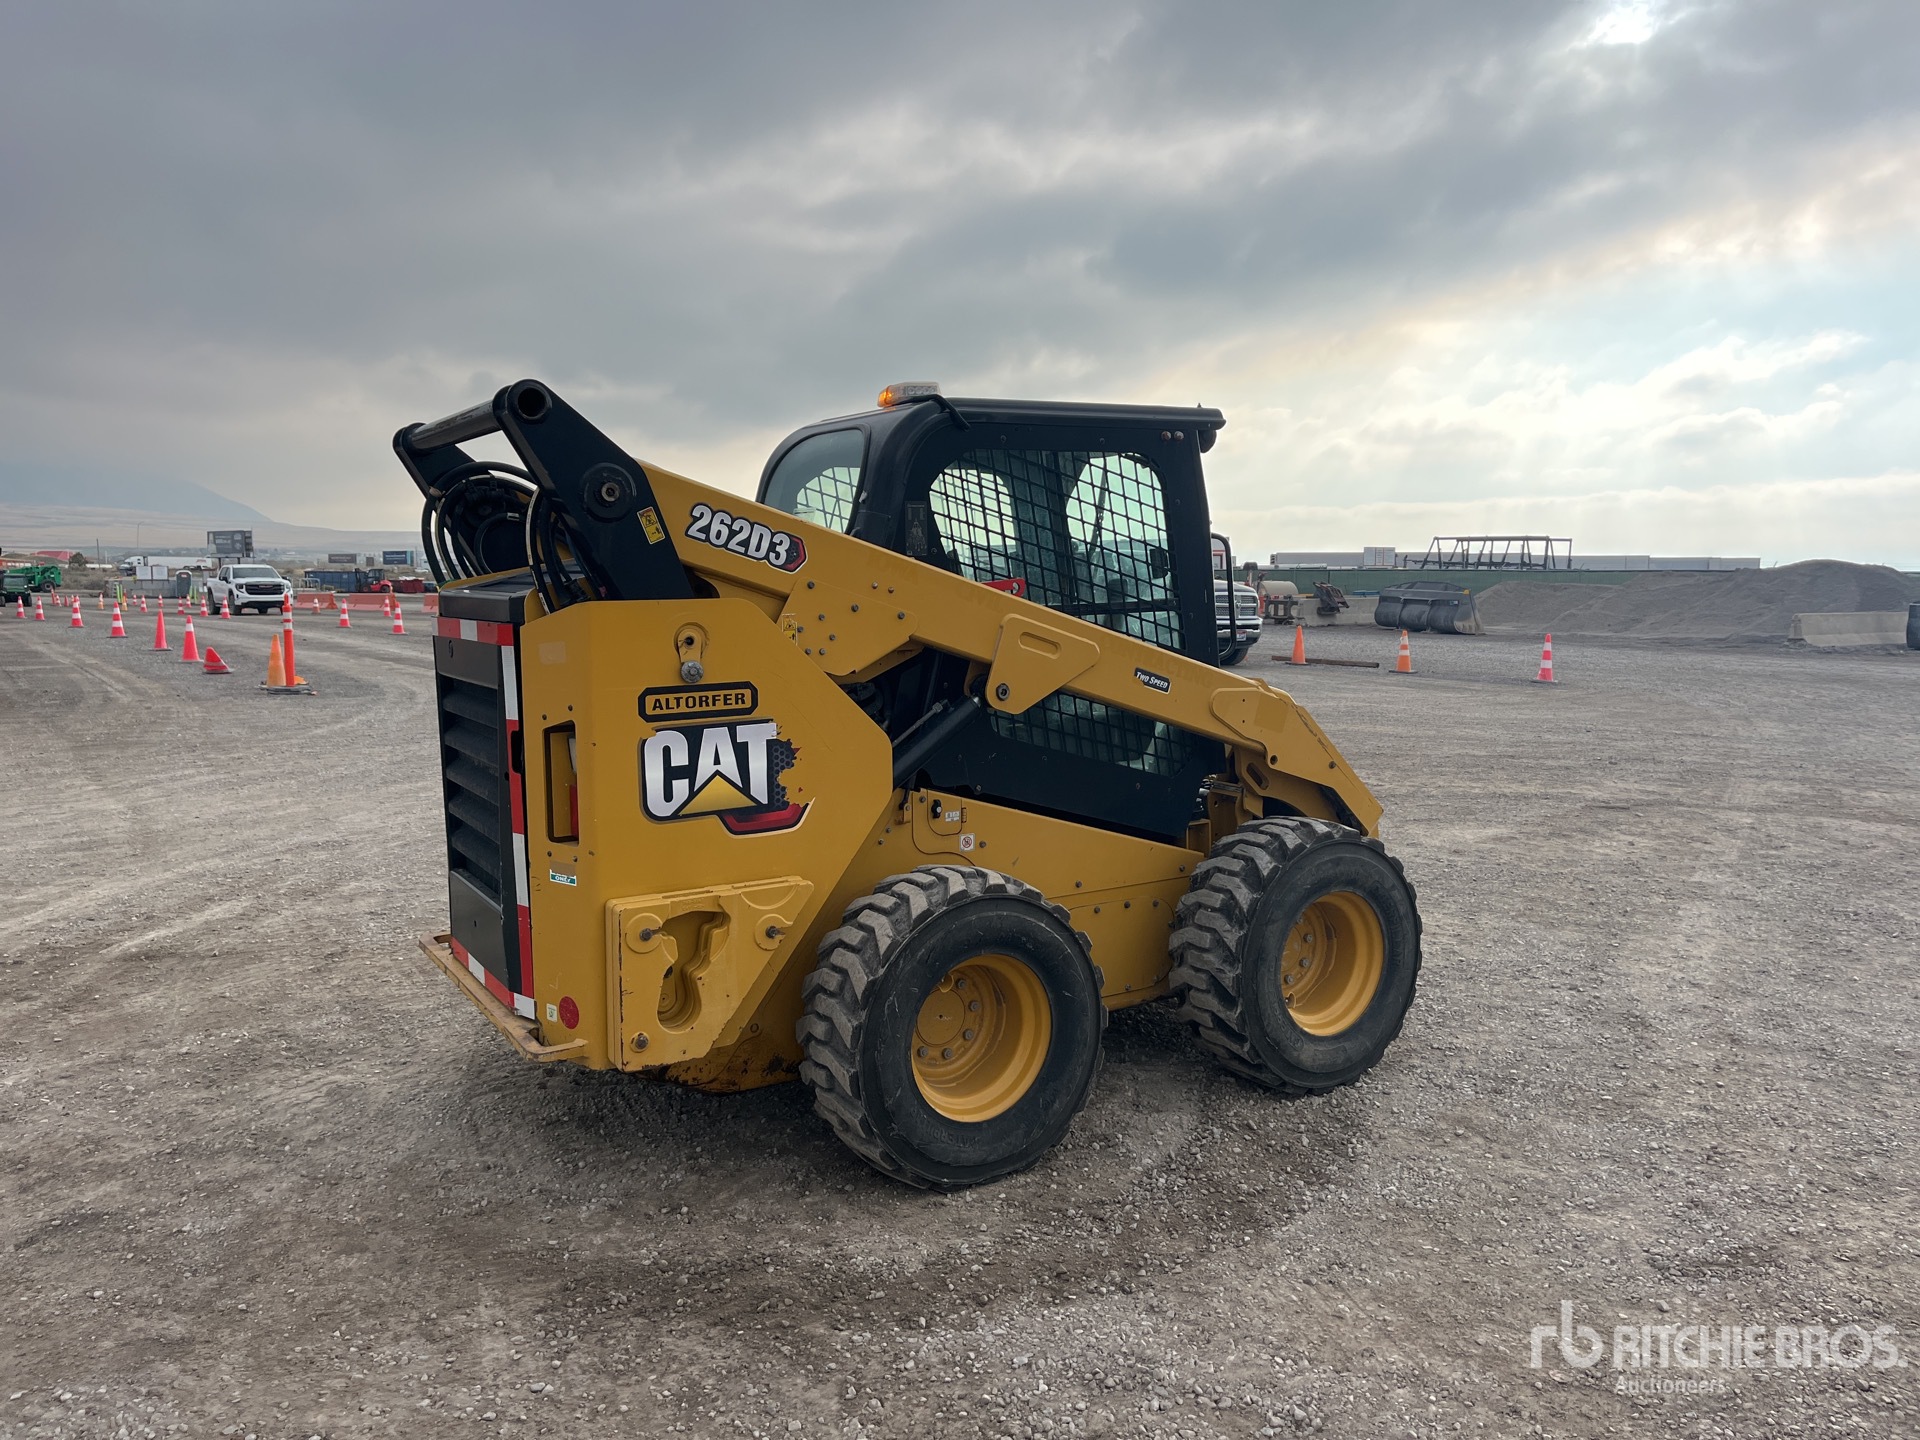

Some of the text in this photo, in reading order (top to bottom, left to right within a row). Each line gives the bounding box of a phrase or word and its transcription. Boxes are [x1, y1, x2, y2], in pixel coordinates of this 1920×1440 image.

[687, 504, 791, 566] 262D3
[651, 692, 746, 711] ALTORFER
[644, 722, 778, 817] CAT
